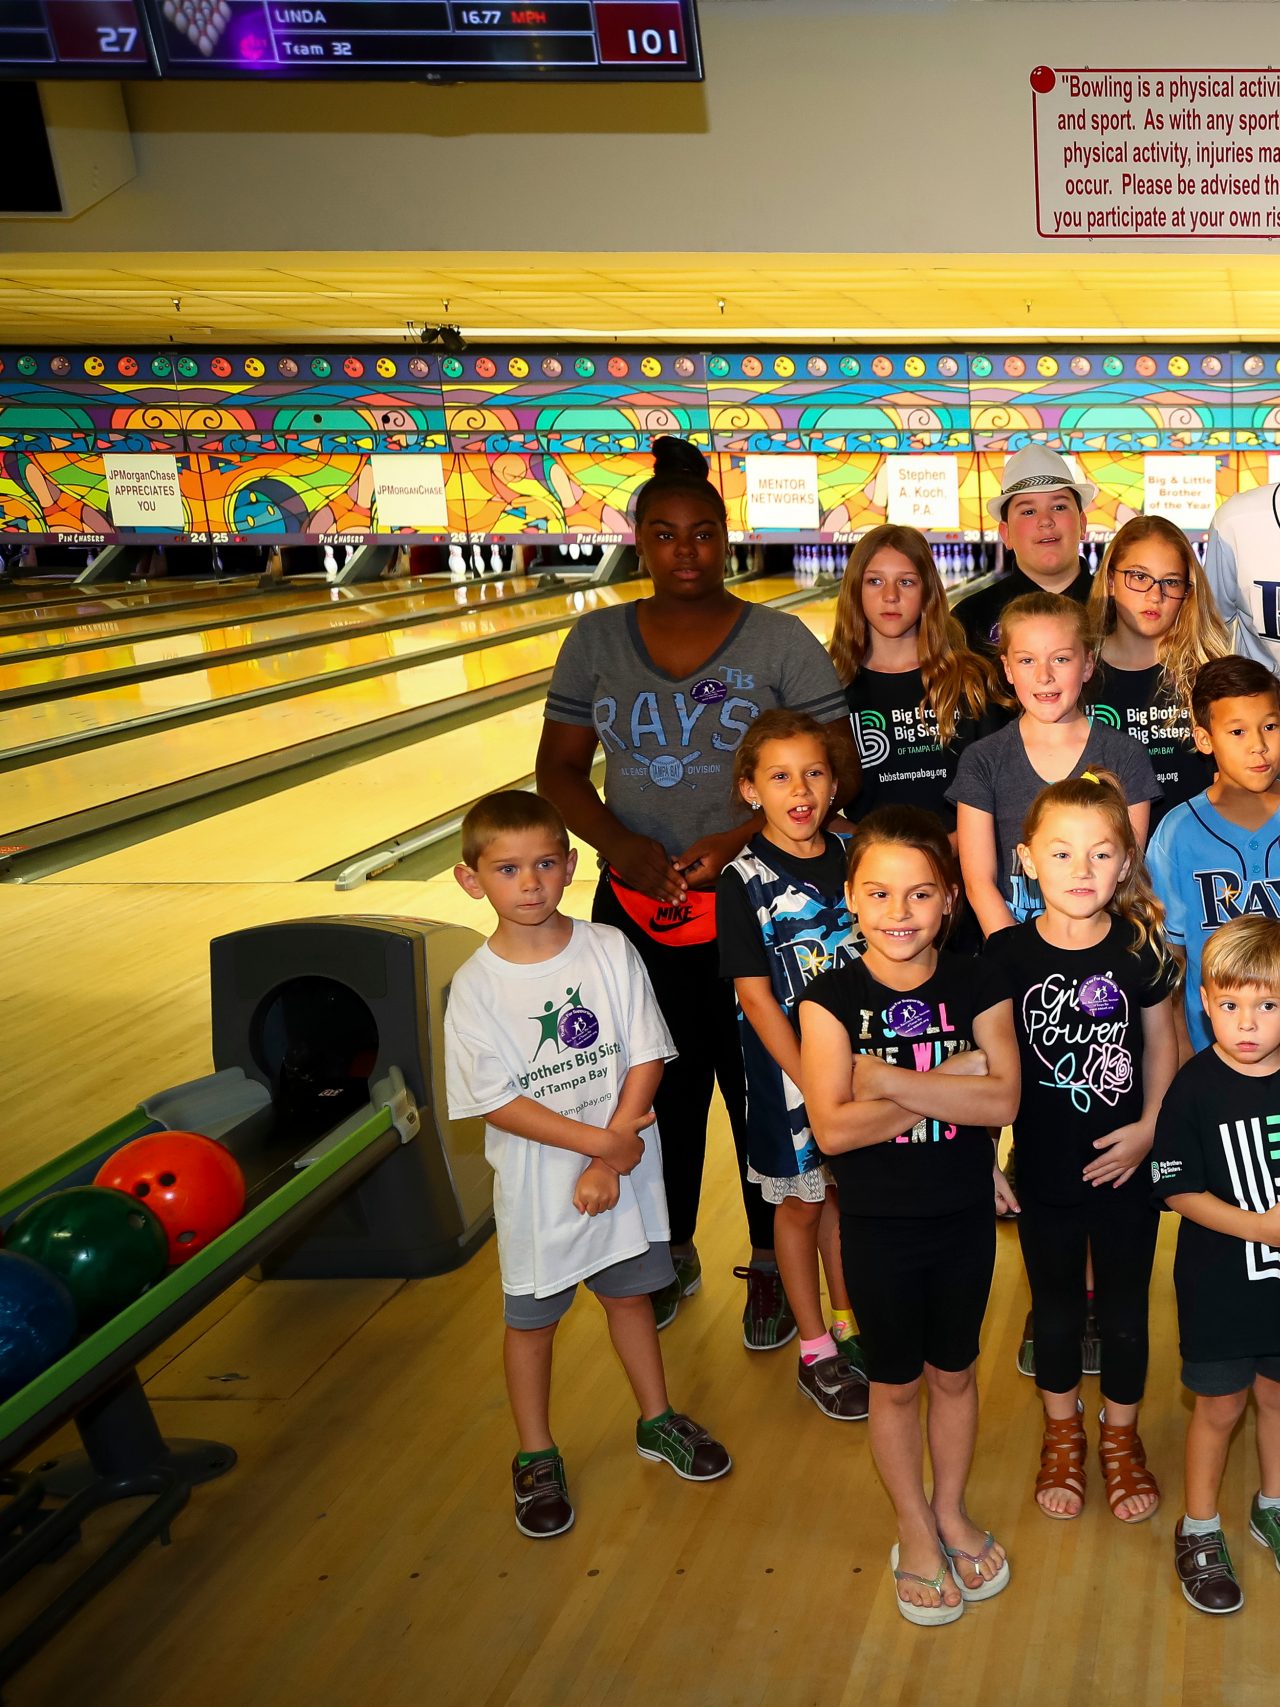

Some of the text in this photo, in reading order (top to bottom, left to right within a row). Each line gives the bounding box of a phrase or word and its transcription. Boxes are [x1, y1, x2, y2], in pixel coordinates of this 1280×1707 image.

[276, 10, 326, 23] LINDA
[462, 11, 546, 24] 16.77 MPH
[97, 28, 137, 52] 27
[627, 29, 678, 54] 101
[282, 42, 352, 55] Team 32
[1062, 75, 1132, 102] "Bowling
[1138, 76, 1150, 97] is
[1156, 80, 1164, 97] a
[1170, 76, 1234, 102] physical
[1058, 108, 1086, 130] and
[1091, 111, 1135, 135] sport.
[1144, 109, 1164, 130] As
[1169, 108, 1201, 130] with
[1206, 114, 1233, 136] any
[1239, 111, 1279, 136] sport
[1064, 141, 1127, 168] physical
[1133, 141, 1191, 168] activity,
[1197, 141, 1253, 168] injuries
[1066, 179, 1112, 195] occur.
[1122, 173, 1172, 195] Please
[1178, 173, 1195, 195] be
[1201, 173, 1260, 195] advised
[1054, 211, 1082, 232] you
[1087, 206, 1166, 232] participate
[1172, 208, 1185, 227] at
[1190, 211, 1224, 232] your
[1229, 211, 1261, 227] own
[109, 470, 176, 482] JPMorganChase
[899, 469, 946, 482] Stephen
[1148, 476, 1165, 487] Big
[1184, 476, 1212, 485] Little
[758, 478, 806, 490] MENTOR
[115, 486, 175, 496] APPRECIATES
[900, 487, 911, 498] A.
[751, 493, 815, 505] NETWORKS
[137, 501, 156, 511] YOU
[913, 504, 934, 515] P.A.
[1149, 502, 1211, 510] of the Year
[58, 533, 105, 543] PIN CHASERS
[190, 533, 207, 543] 24
[213, 533, 229, 543] 25
[450, 532, 466, 543] 26
[470, 532, 486, 543] 27
[963, 531, 980, 542] 30
[718, 665, 756, 690] TB
[593, 692, 761, 752] RAYS
[892, 709, 914, 725] Big
[1127, 708, 1147, 725] Big
[894, 728, 916, 743] Big
[1128, 727, 1150, 744] Big
[897, 747, 907, 755] OF
[908, 744, 931, 754] TAMPA
[631, 767, 648, 776] EAST
[688, 764, 721, 775] DIVISION
[878, 768, 947, 783] bbbstampabay.org
[656, 905, 693, 921] NIKE
[1029, 1010, 1129, 1046] Power
[527, 1050, 597, 1082] rothers Big
[533, 1066, 609, 1098] of Tampa Bay
